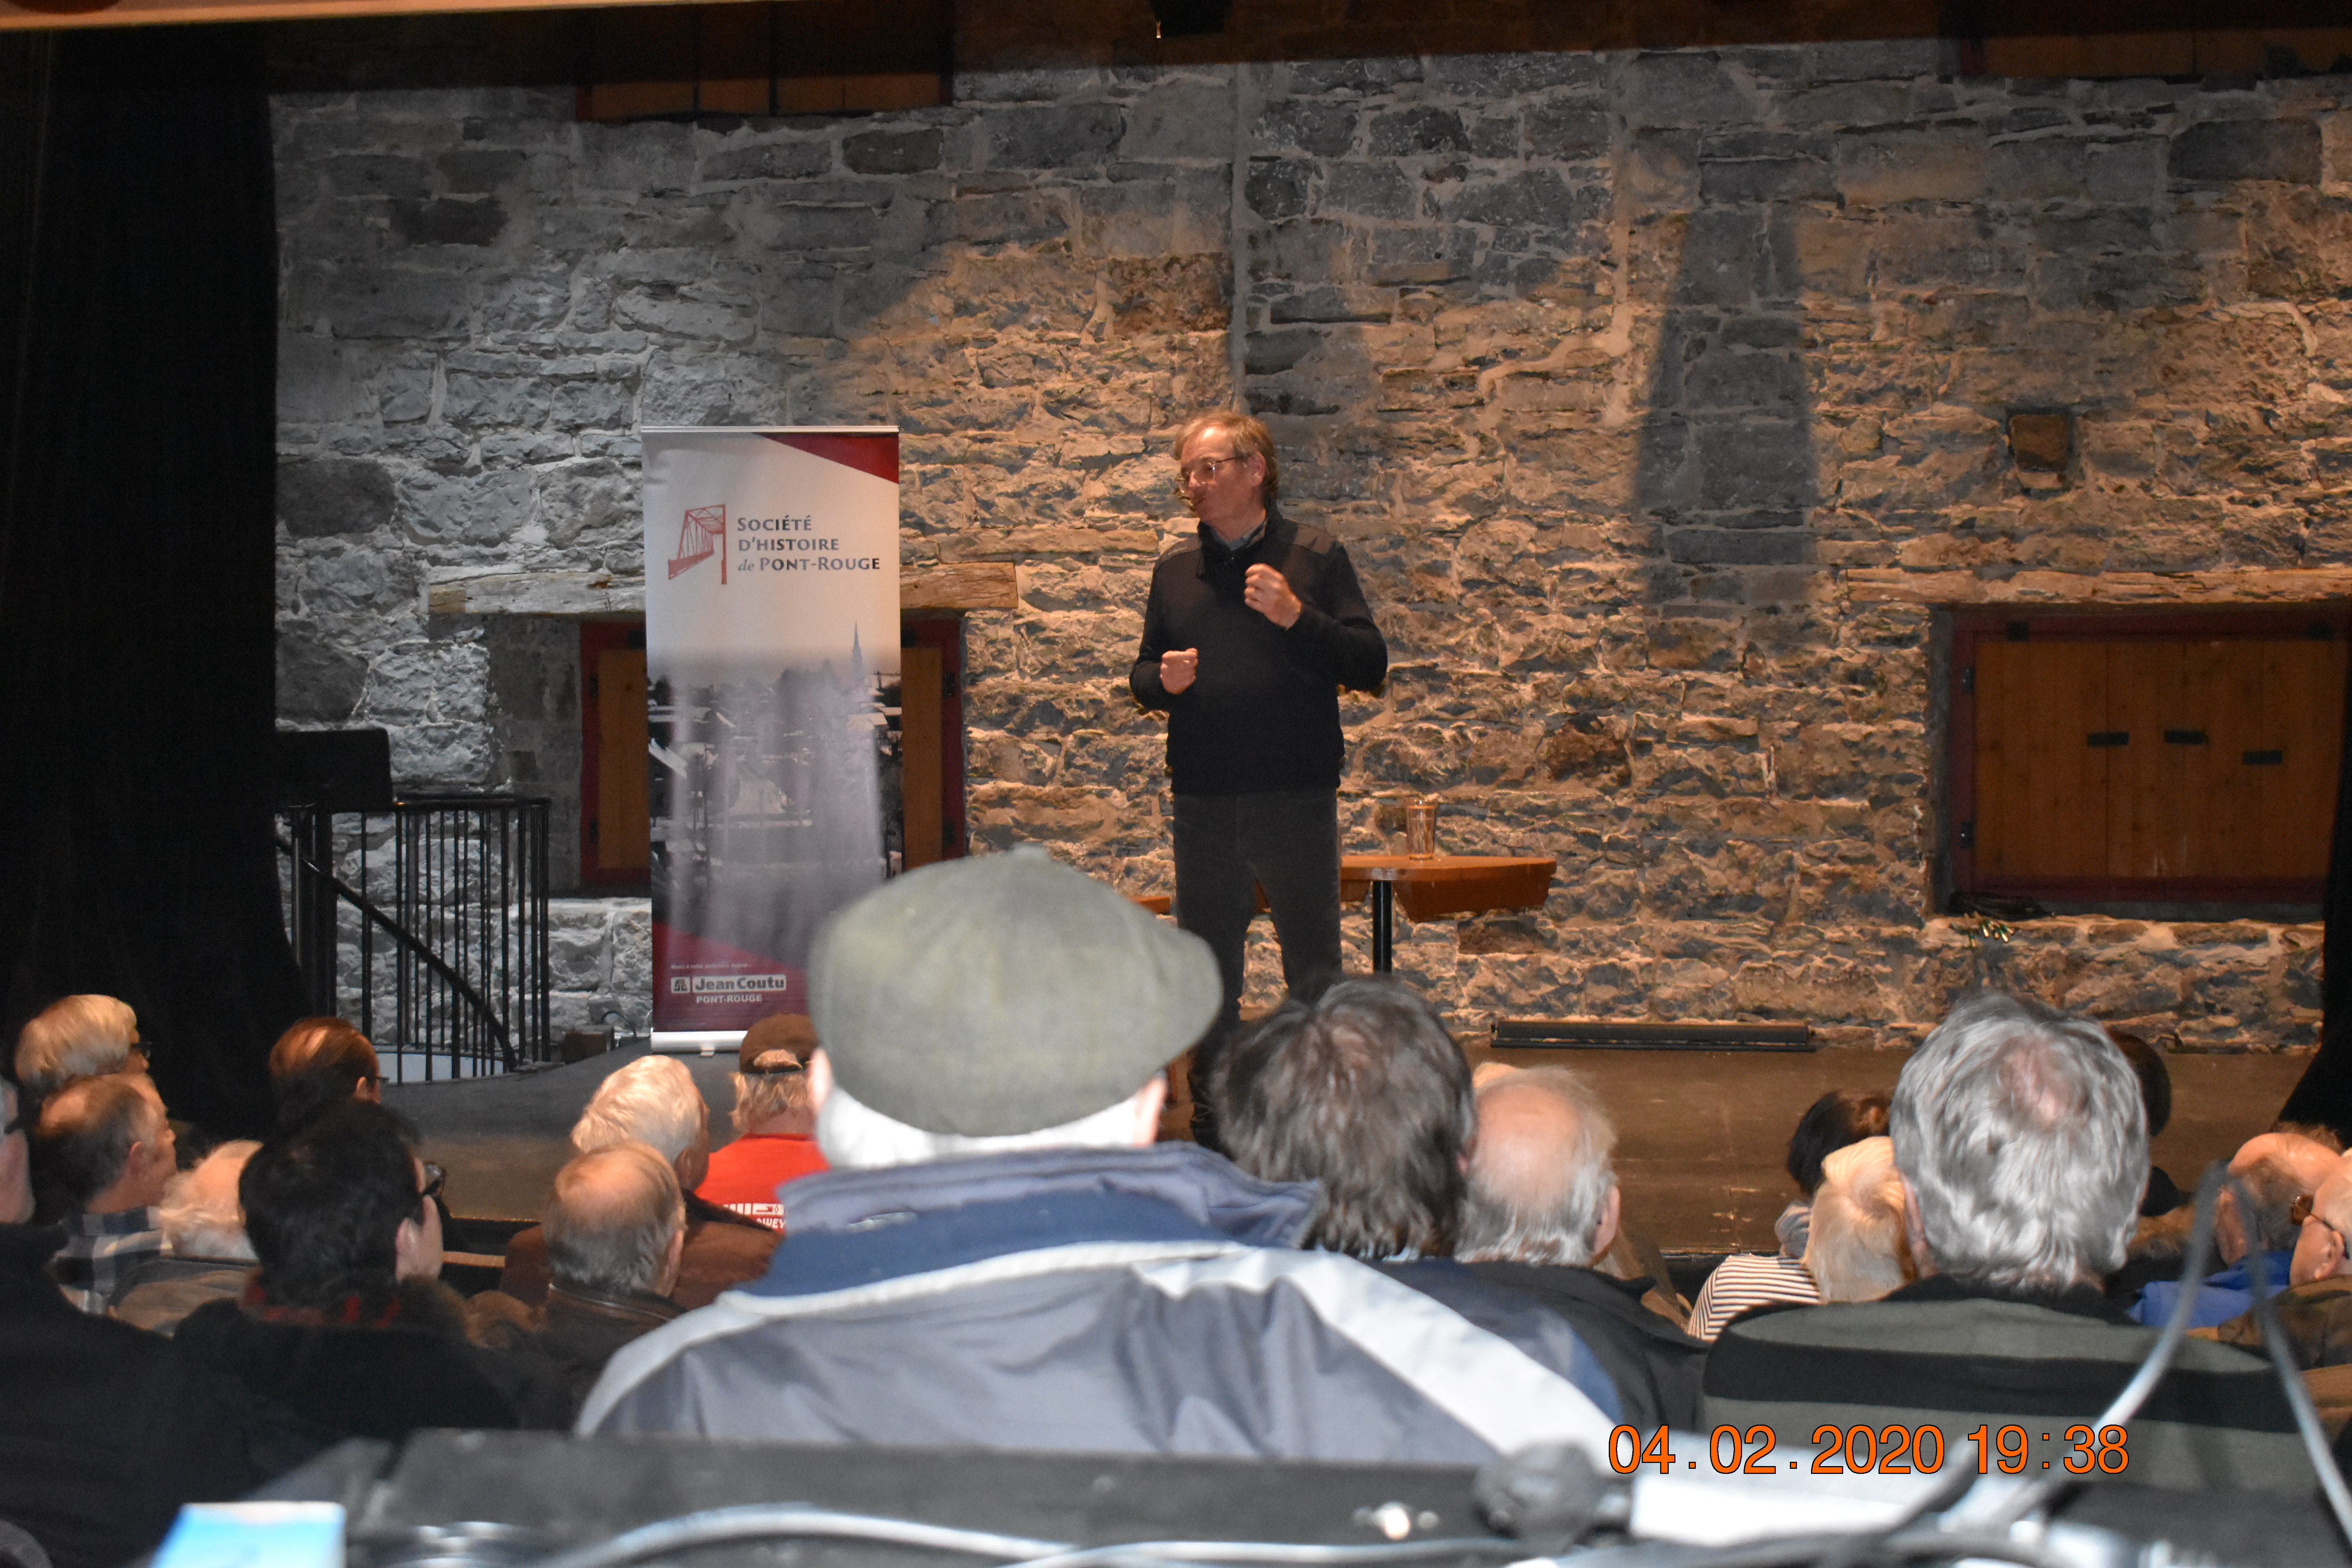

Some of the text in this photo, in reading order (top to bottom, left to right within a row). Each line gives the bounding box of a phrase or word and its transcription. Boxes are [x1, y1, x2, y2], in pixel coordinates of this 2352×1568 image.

[737, 515, 812, 532] SOCIÉTÉ
[738, 537, 839, 551] D'HISTOIRE
[738, 557, 880, 571] de PONT-ROUGE
[695, 976, 784, 991] Jean Coutu
[696, 994, 762, 1004] PONT-ROUGE
